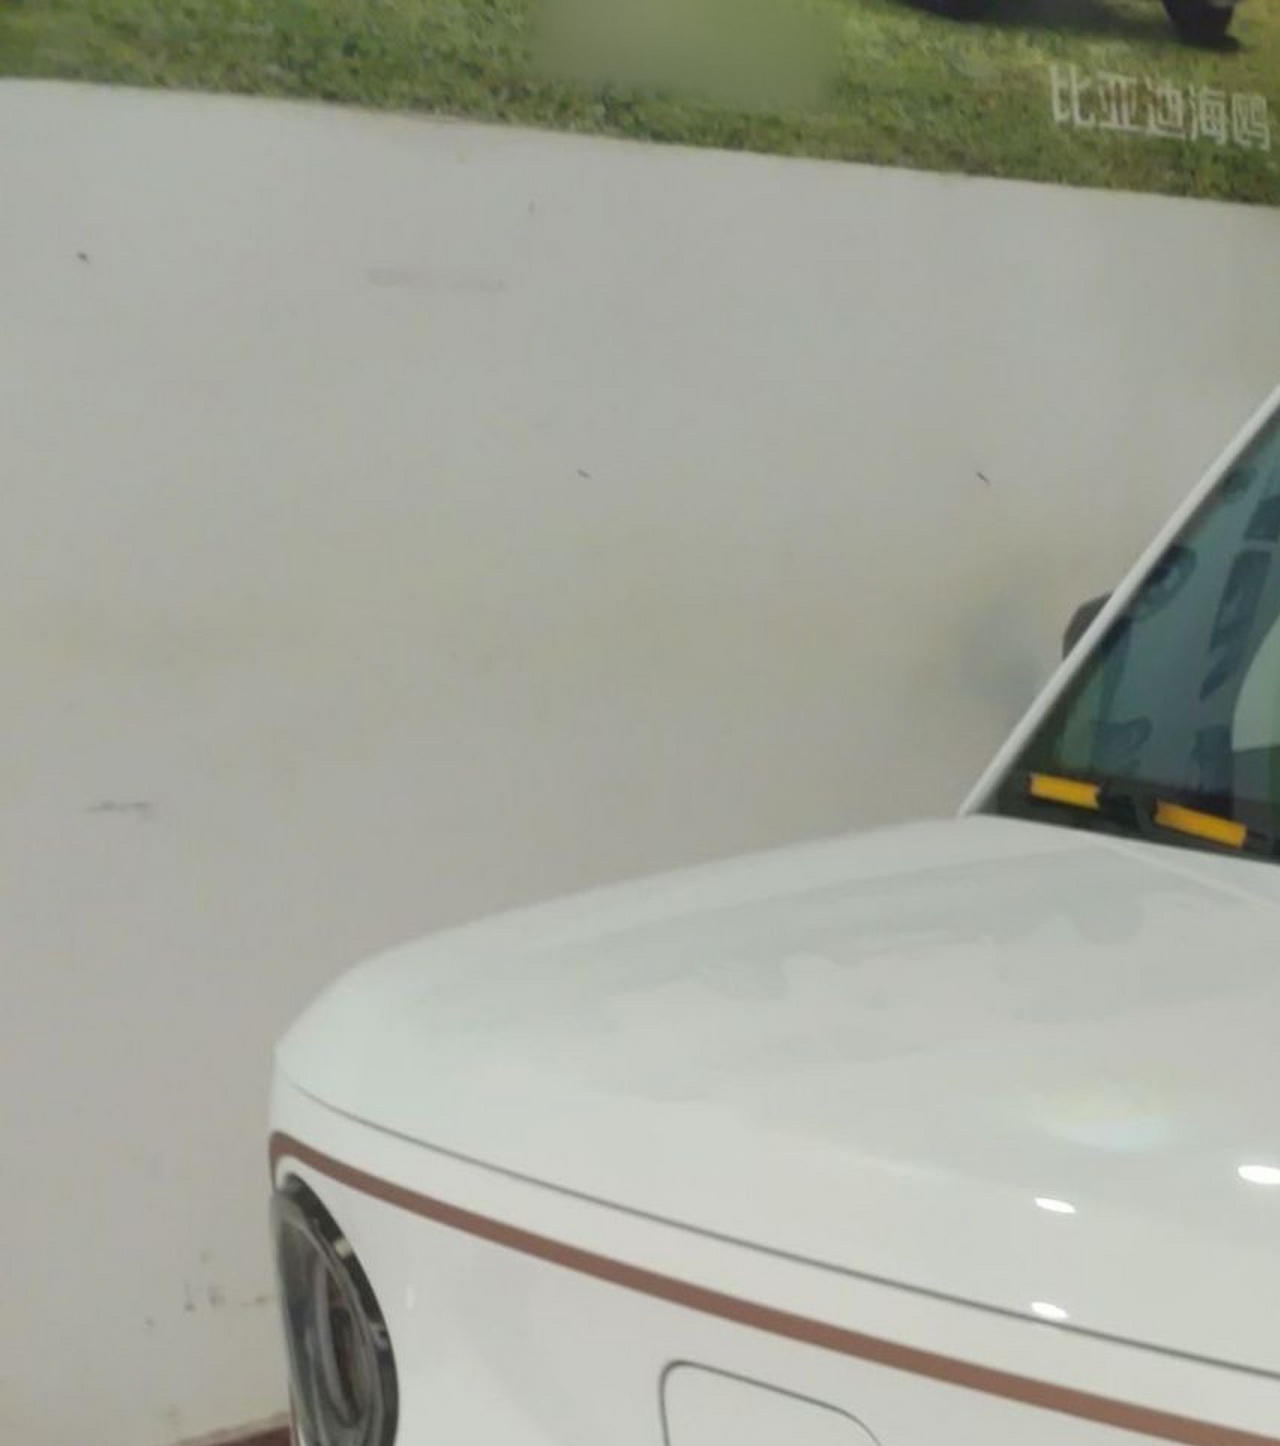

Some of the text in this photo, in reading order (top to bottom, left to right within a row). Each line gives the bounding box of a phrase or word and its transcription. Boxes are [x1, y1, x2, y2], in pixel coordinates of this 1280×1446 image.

[1050, 64, 1272, 151] 比亚迪海鸥
